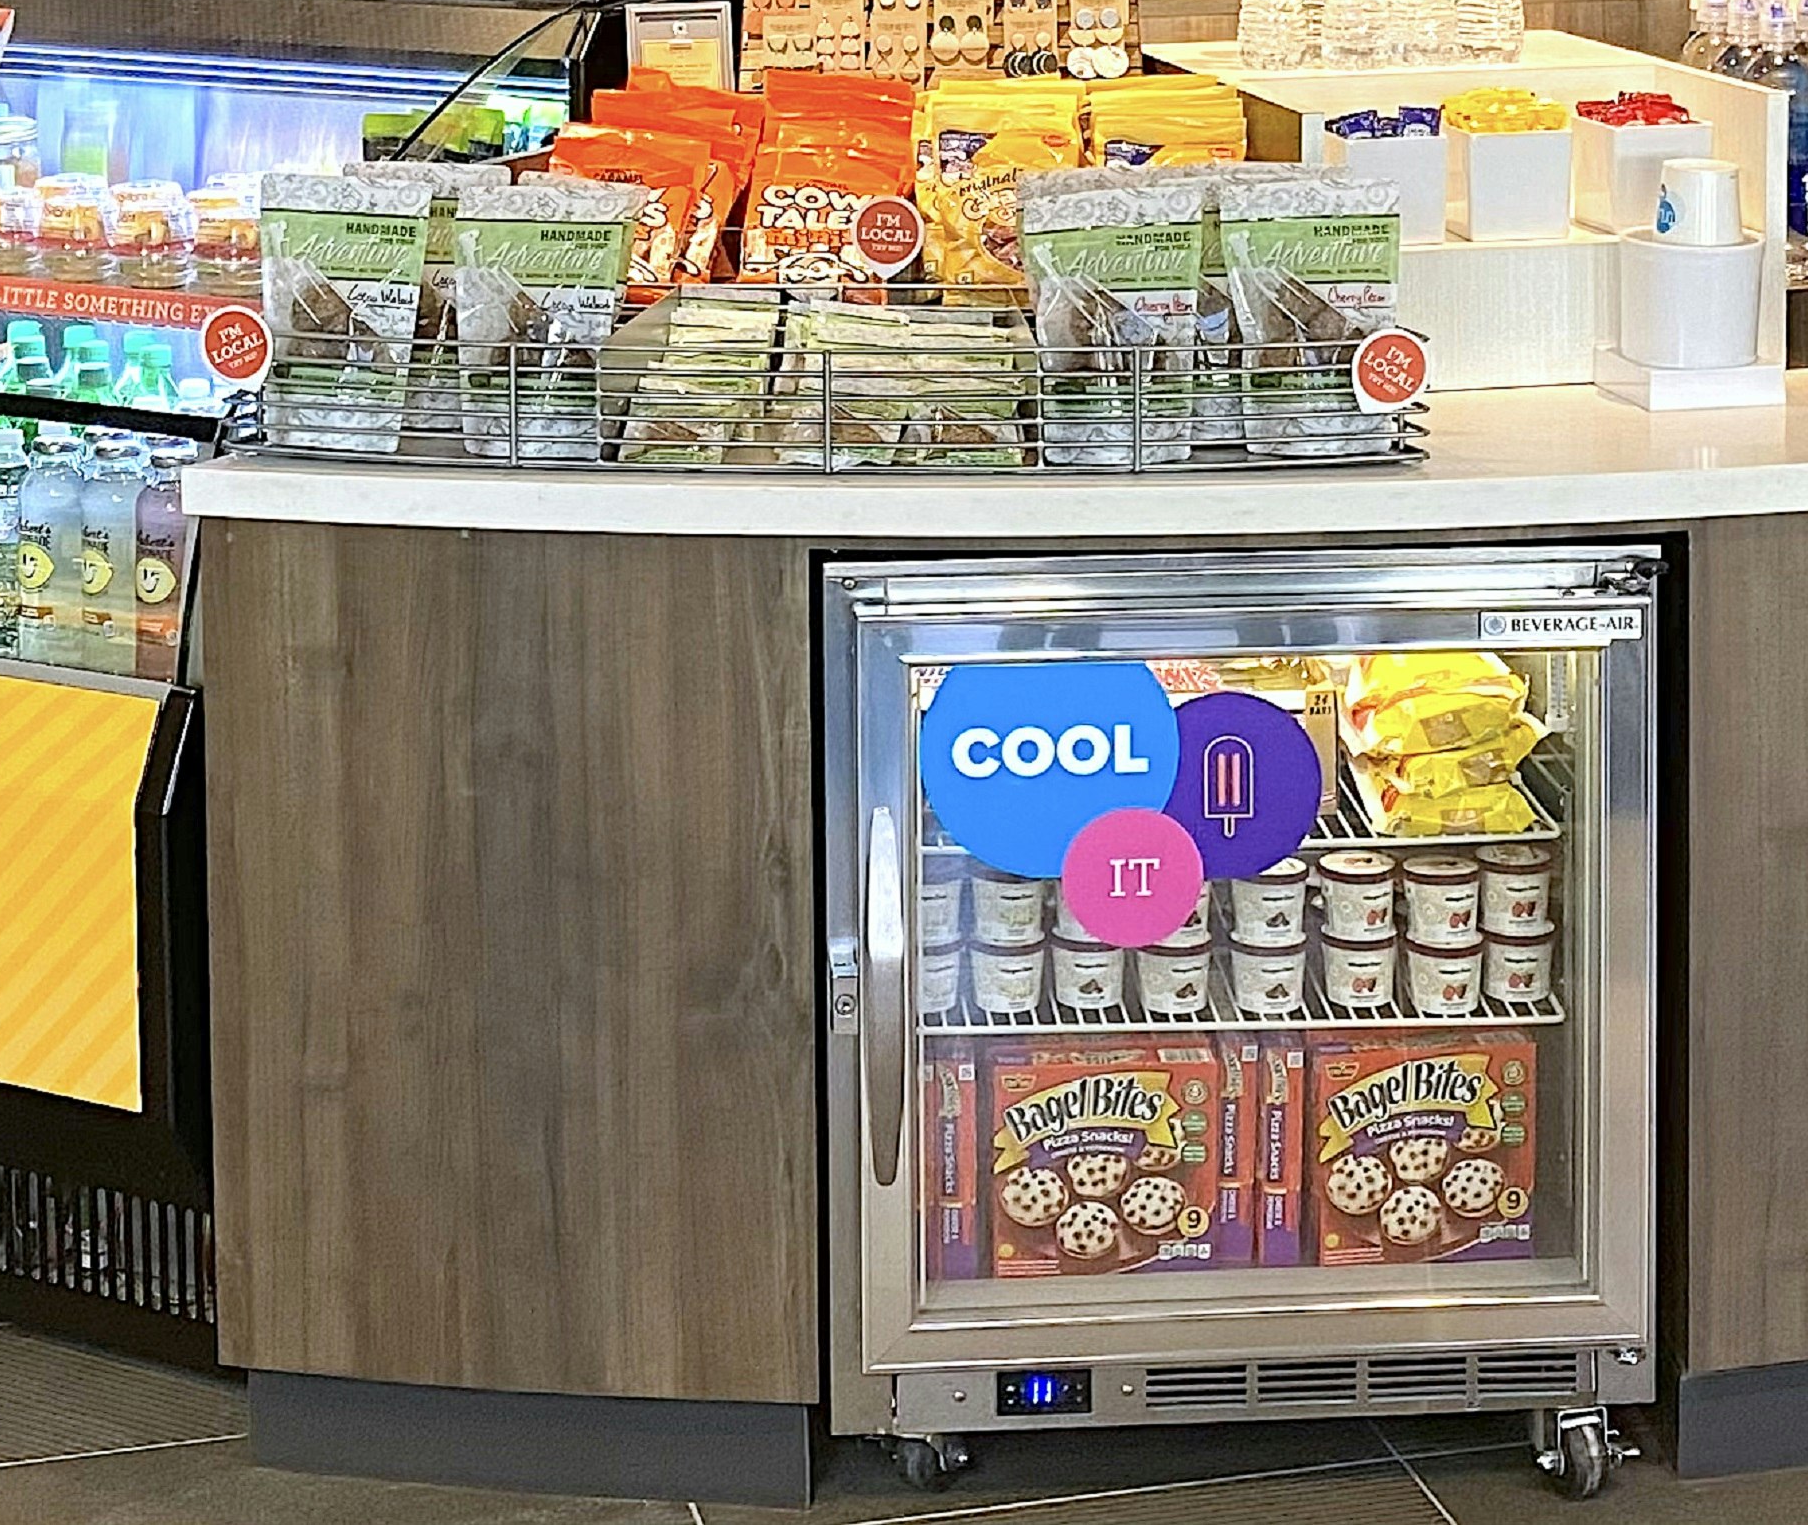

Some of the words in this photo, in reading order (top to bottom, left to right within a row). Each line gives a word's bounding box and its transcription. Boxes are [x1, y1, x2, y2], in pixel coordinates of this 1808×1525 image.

[762, 184, 873, 210] COW
[346, 222, 416, 238] HANDMADE
[875, 213, 901, 228] I'M
[1313, 224, 1390, 238] HANDMADE
[541, 229, 612, 243] HANDMADE
[860, 227, 915, 244] LOCAL
[1115, 231, 1191, 246] HANDMADE
[295, 233, 410, 266] Adventure
[487, 241, 605, 271] Adventure
[1066, 244, 1185, 278] Adventure
[1262, 236, 1385, 271] Adventure
[62, 291, 184, 323] SOMETHING
[217, 323, 245, 346] I'M
[211, 333, 265, 365] LOCAL
[1385, 346, 1414, 369] I'M
[1364, 350, 1418, 393] LOCAL
[1511, 615, 1635, 633] BEVERAGE-AIR
[950, 723, 1151, 779] COOL
[1108, 857, 1162, 898] IT
[1328, 1061, 1407, 1131] Bagel
[1414, 1061, 1482, 1104] Bites
[1004, 1077, 1087, 1143] Bagel
[1093, 1077, 1162, 1122] Bites
[1367, 1118, 1402, 1138] Pizza
[1403, 1115, 1454, 1128] Snacks!
[1043, 1134, 1079, 1151] Pizza
[1081, 1130, 1135, 1145] Snacks!
[1507, 1191, 1521, 1210] 9
[1187, 1208, 1200, 1228] 9
